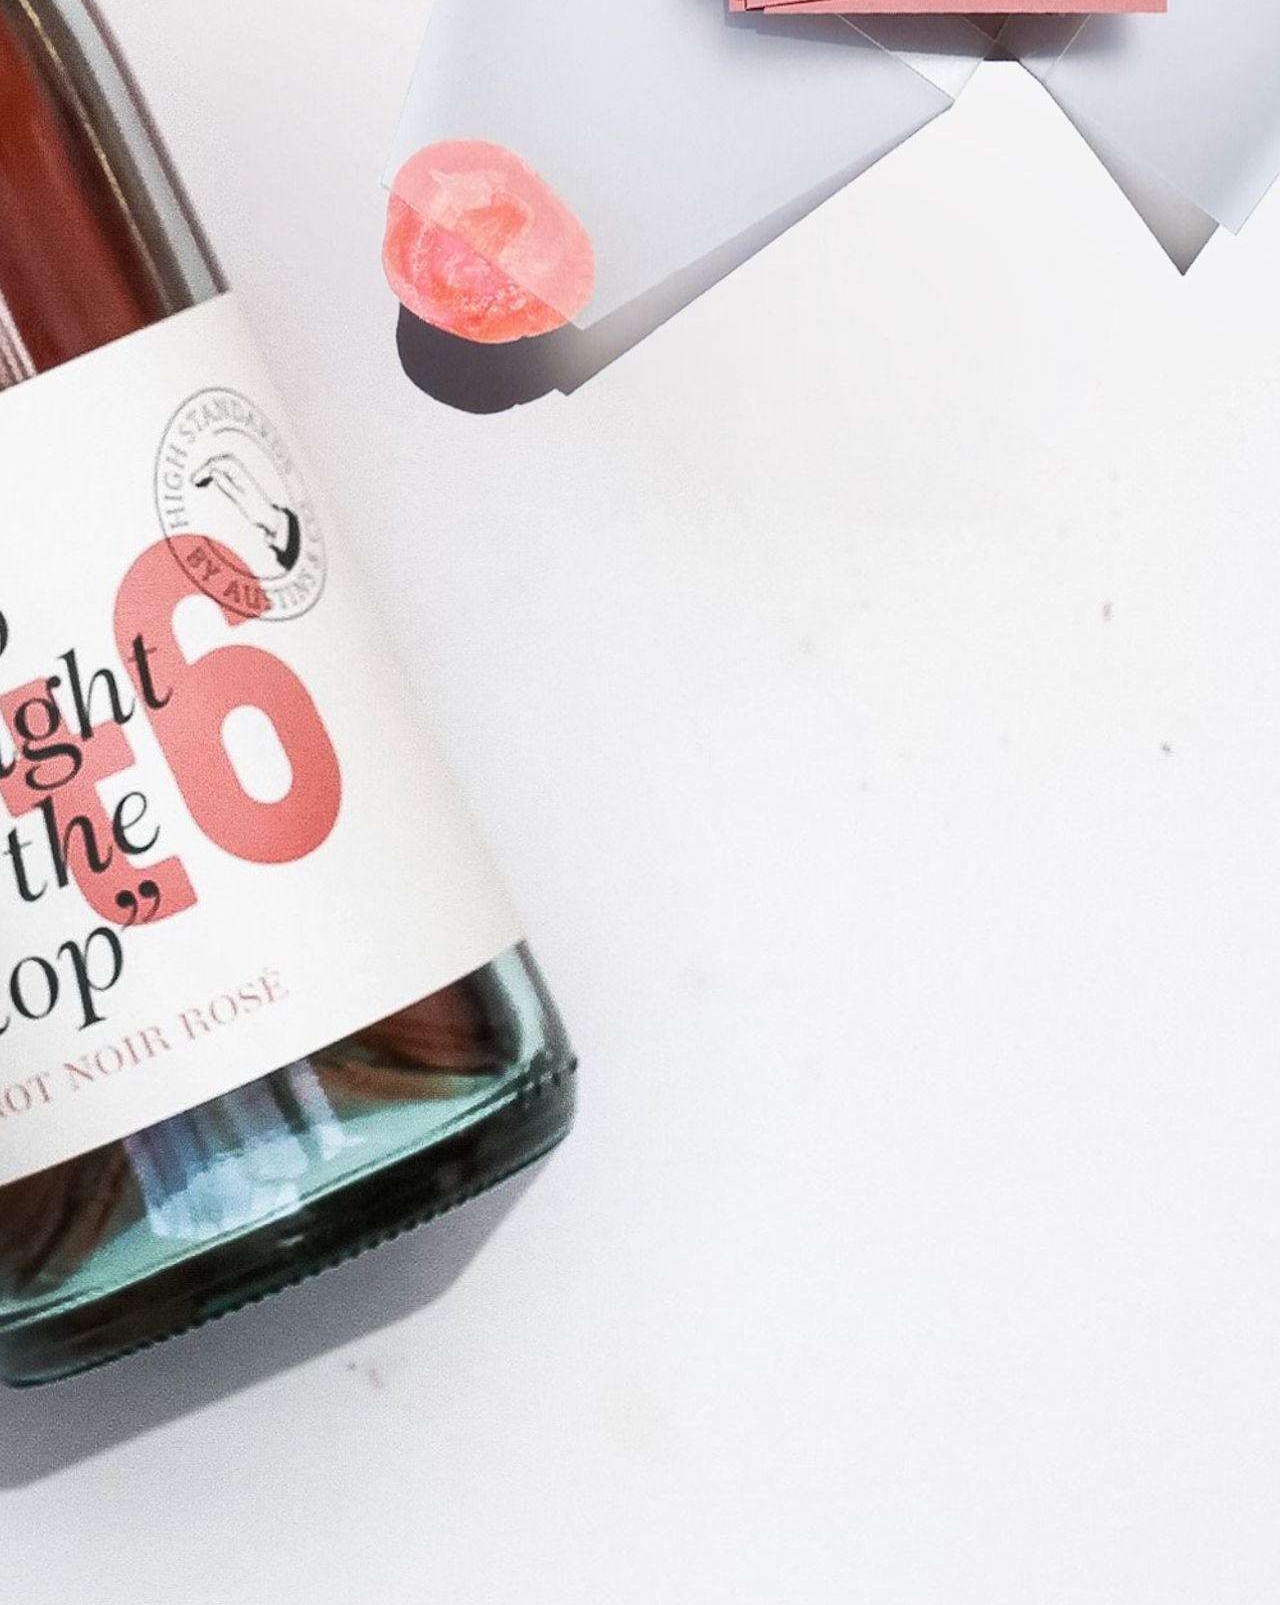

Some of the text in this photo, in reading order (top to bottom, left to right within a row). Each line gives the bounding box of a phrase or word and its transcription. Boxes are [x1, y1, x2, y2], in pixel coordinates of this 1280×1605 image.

[163, 443, 189, 530] HIGH
[186, 545, 221, 583] BY
[2, 792, 161, 902] the
[62, 1025, 172, 1093] NOIR
